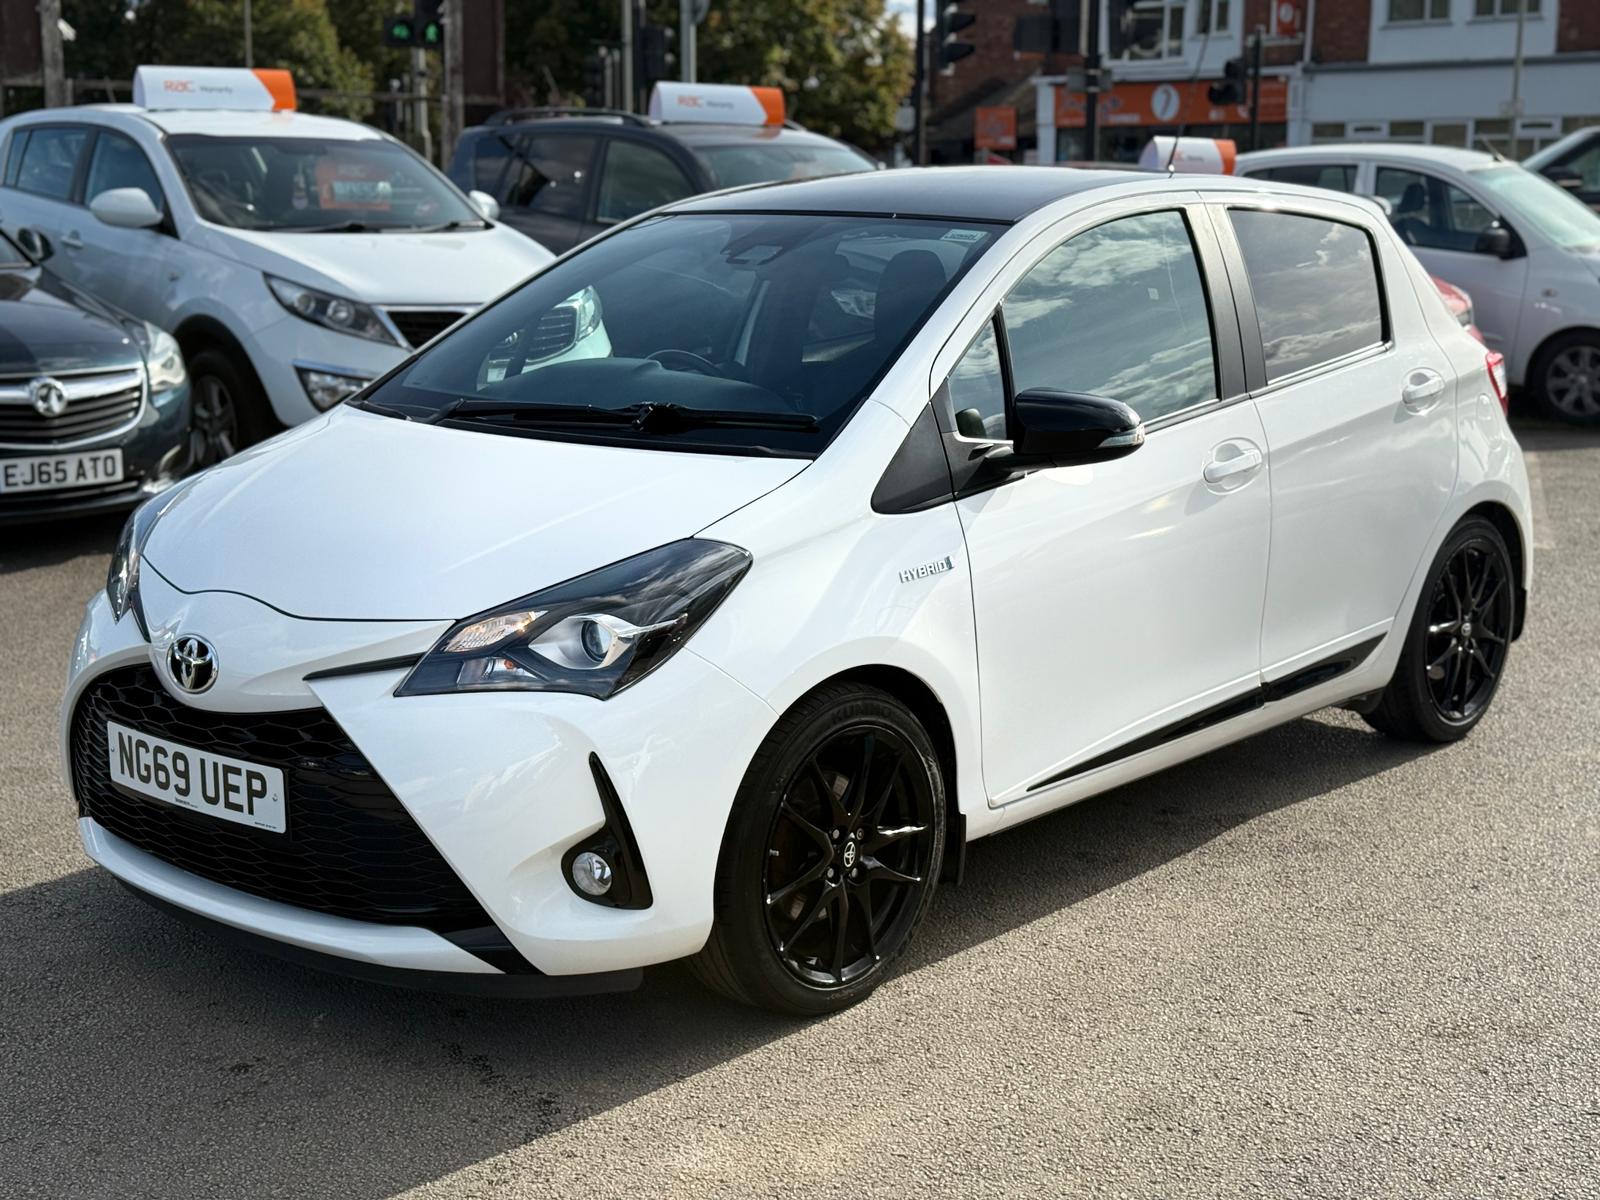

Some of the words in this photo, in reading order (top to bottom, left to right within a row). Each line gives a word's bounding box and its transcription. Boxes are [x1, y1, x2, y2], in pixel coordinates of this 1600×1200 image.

[3, 459, 68, 488] EJ65
[76, 455, 117, 481] ATO
[898, 559, 948, 584] HYBRID
[117, 730, 191, 798] NG69
[199, 757, 268, 816] UEP
